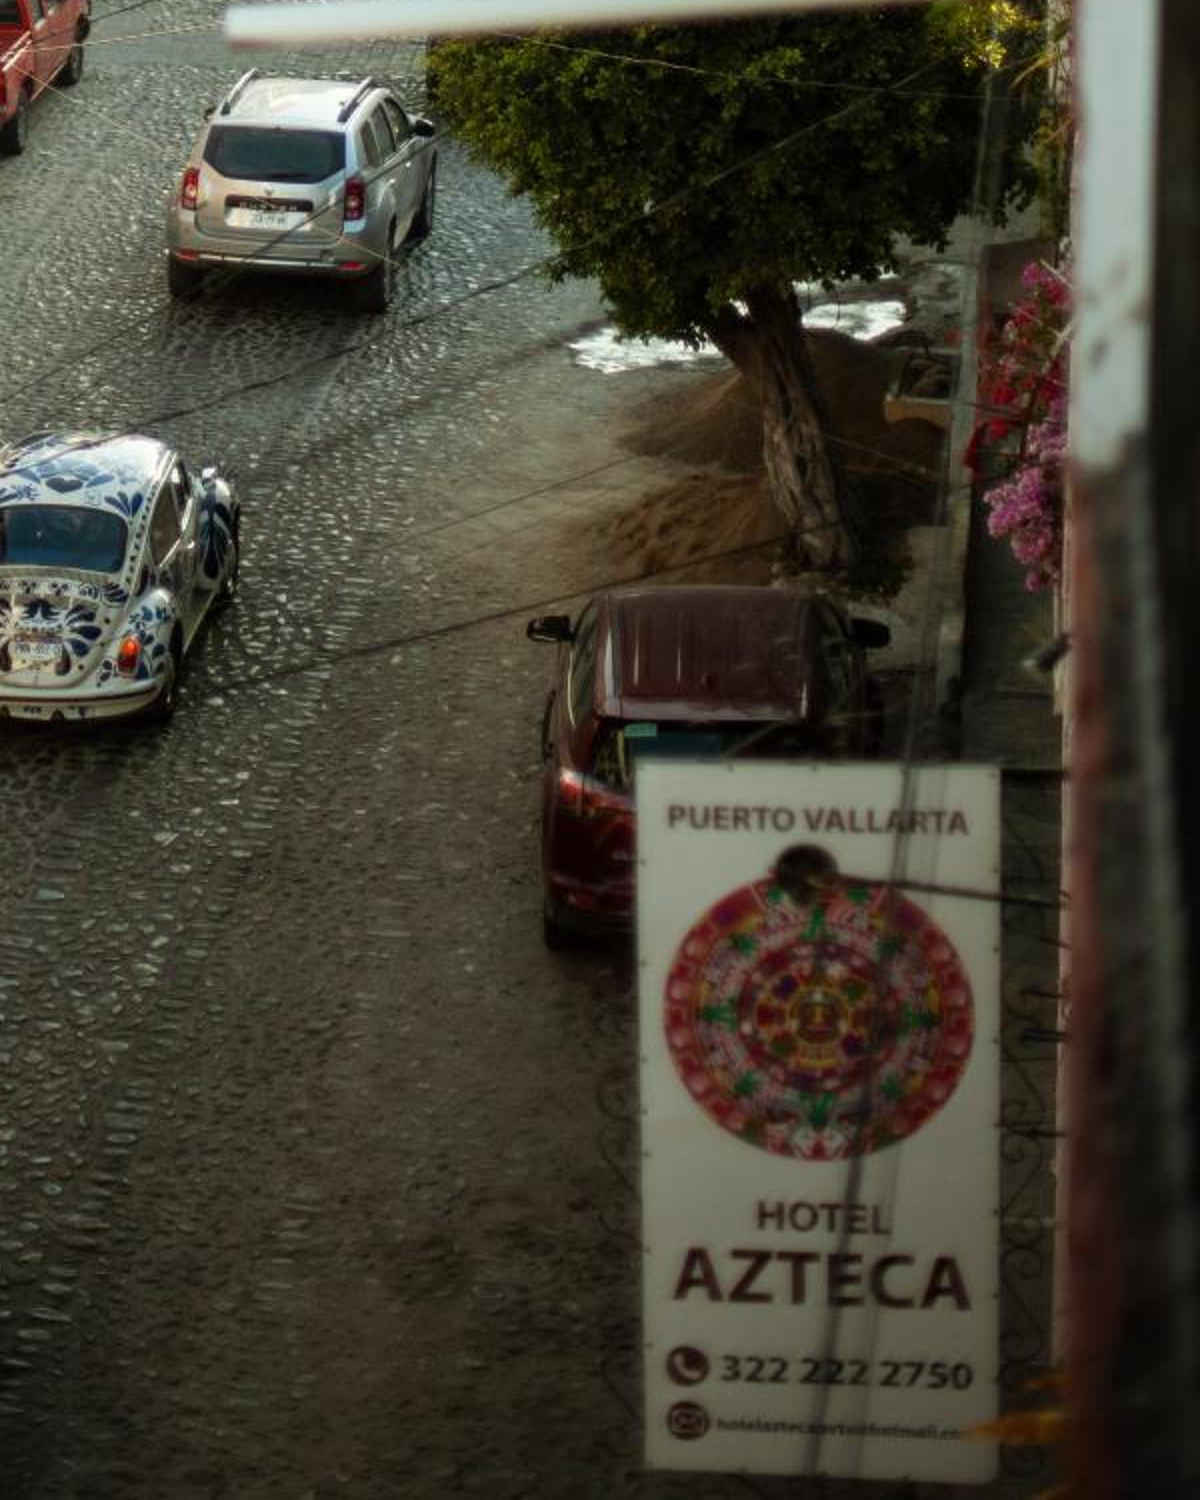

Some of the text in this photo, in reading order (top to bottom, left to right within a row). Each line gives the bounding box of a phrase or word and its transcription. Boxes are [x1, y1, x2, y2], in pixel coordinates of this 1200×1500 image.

[667, 804, 969, 836] PUERTO VALLARTA
[756, 1200, 892, 1236] HOTEL
[673, 1247, 971, 1312] AZTECA
[721, 1355, 974, 1391] 322 222 2750
